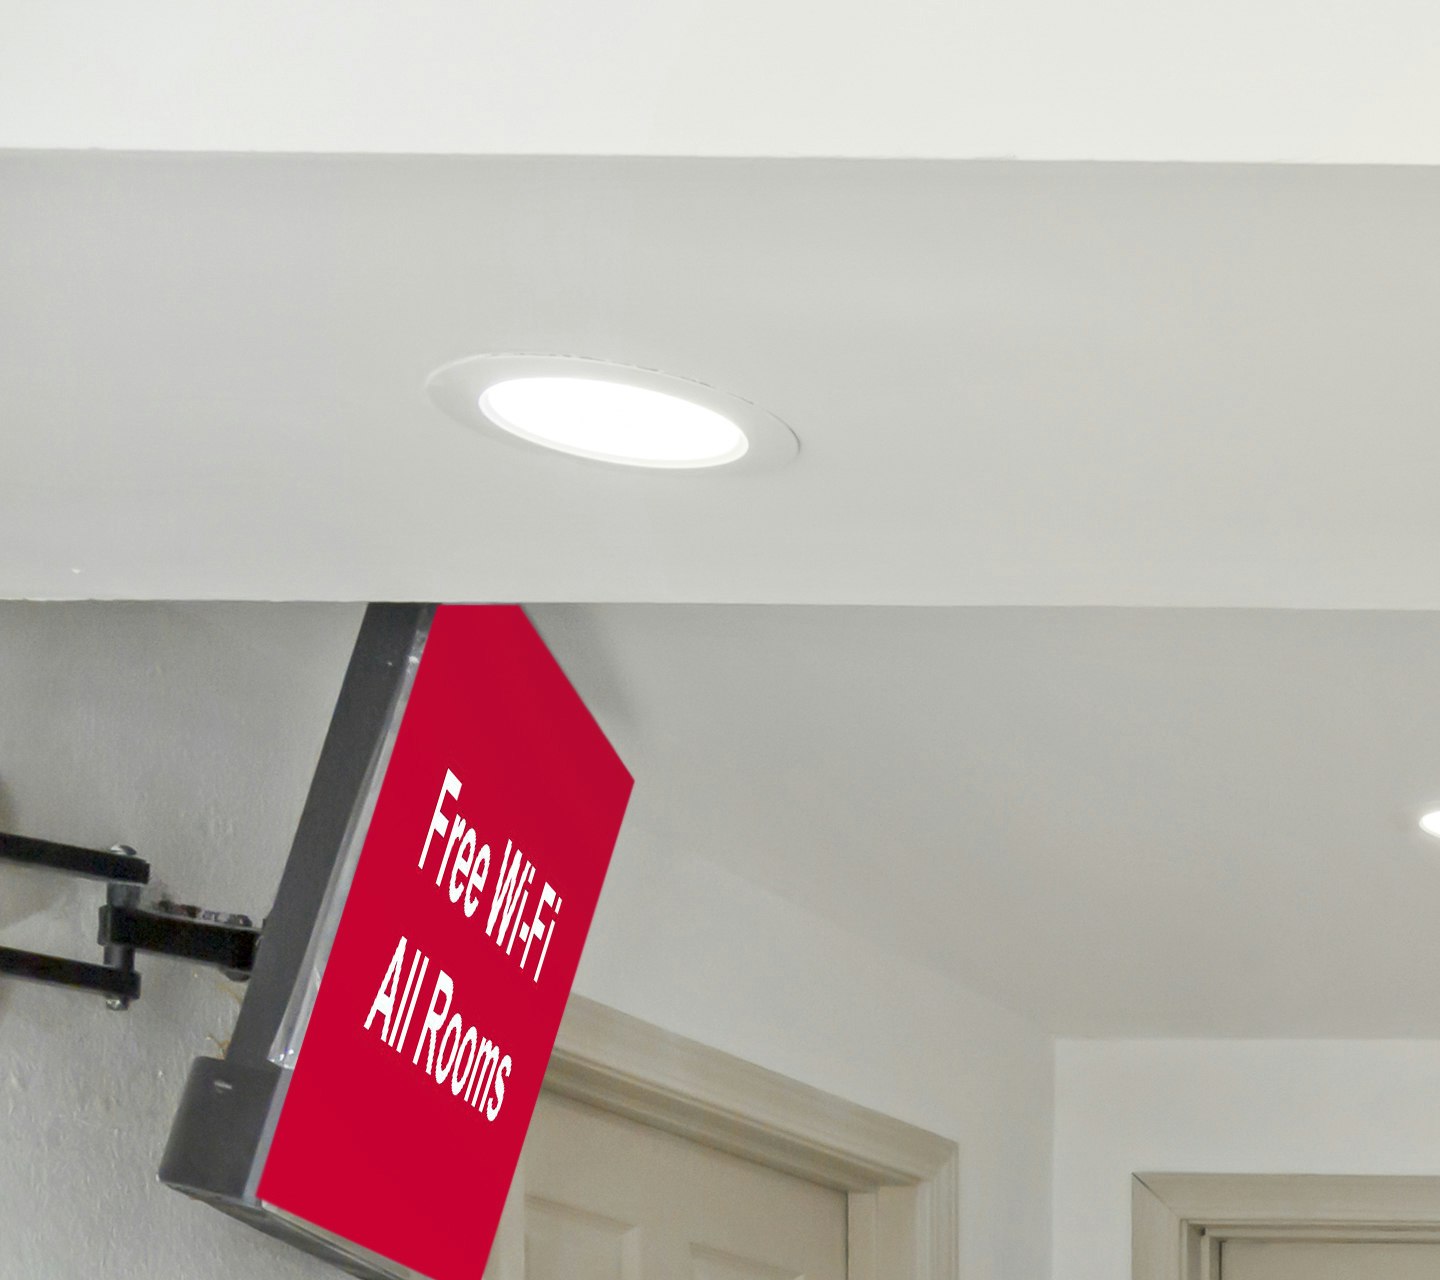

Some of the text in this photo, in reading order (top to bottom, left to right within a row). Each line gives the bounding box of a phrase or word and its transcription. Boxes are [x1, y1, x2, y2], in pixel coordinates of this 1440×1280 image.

[417, 767, 563, 984] Free Wi-Fi
[364, 935, 512, 1122] All Rooms
